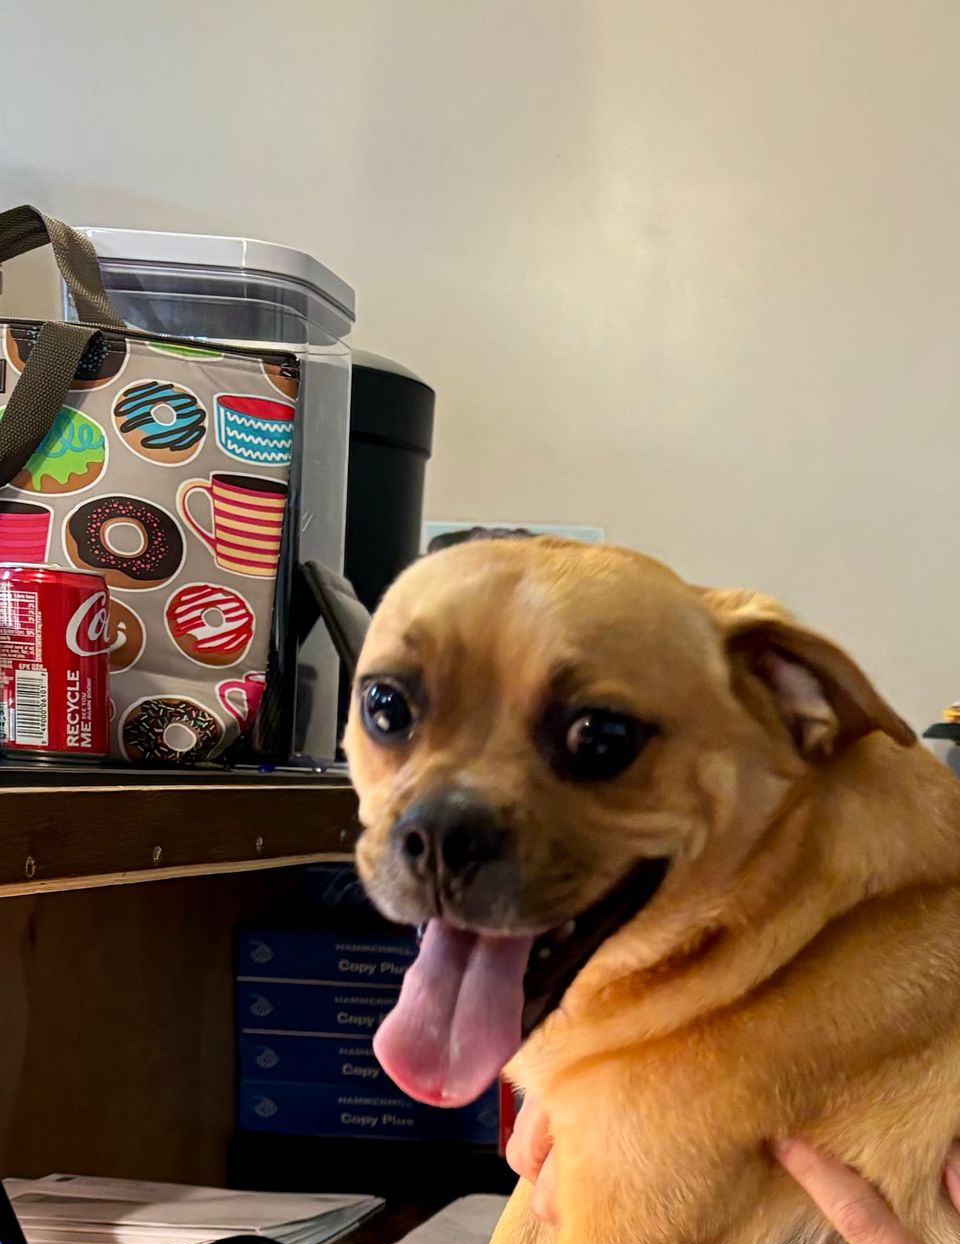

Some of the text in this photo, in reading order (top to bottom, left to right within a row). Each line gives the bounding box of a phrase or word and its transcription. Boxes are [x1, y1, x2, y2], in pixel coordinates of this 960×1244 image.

[66, 670, 80, 747] RECYCLE
[81, 721, 92, 747] ME
[338, 959, 376, 975] Copy
[337, 1012, 374, 1027] Copy
[342, 1063, 379, 1078] Copy
[341, 1112, 414, 1127] Copy Plus
